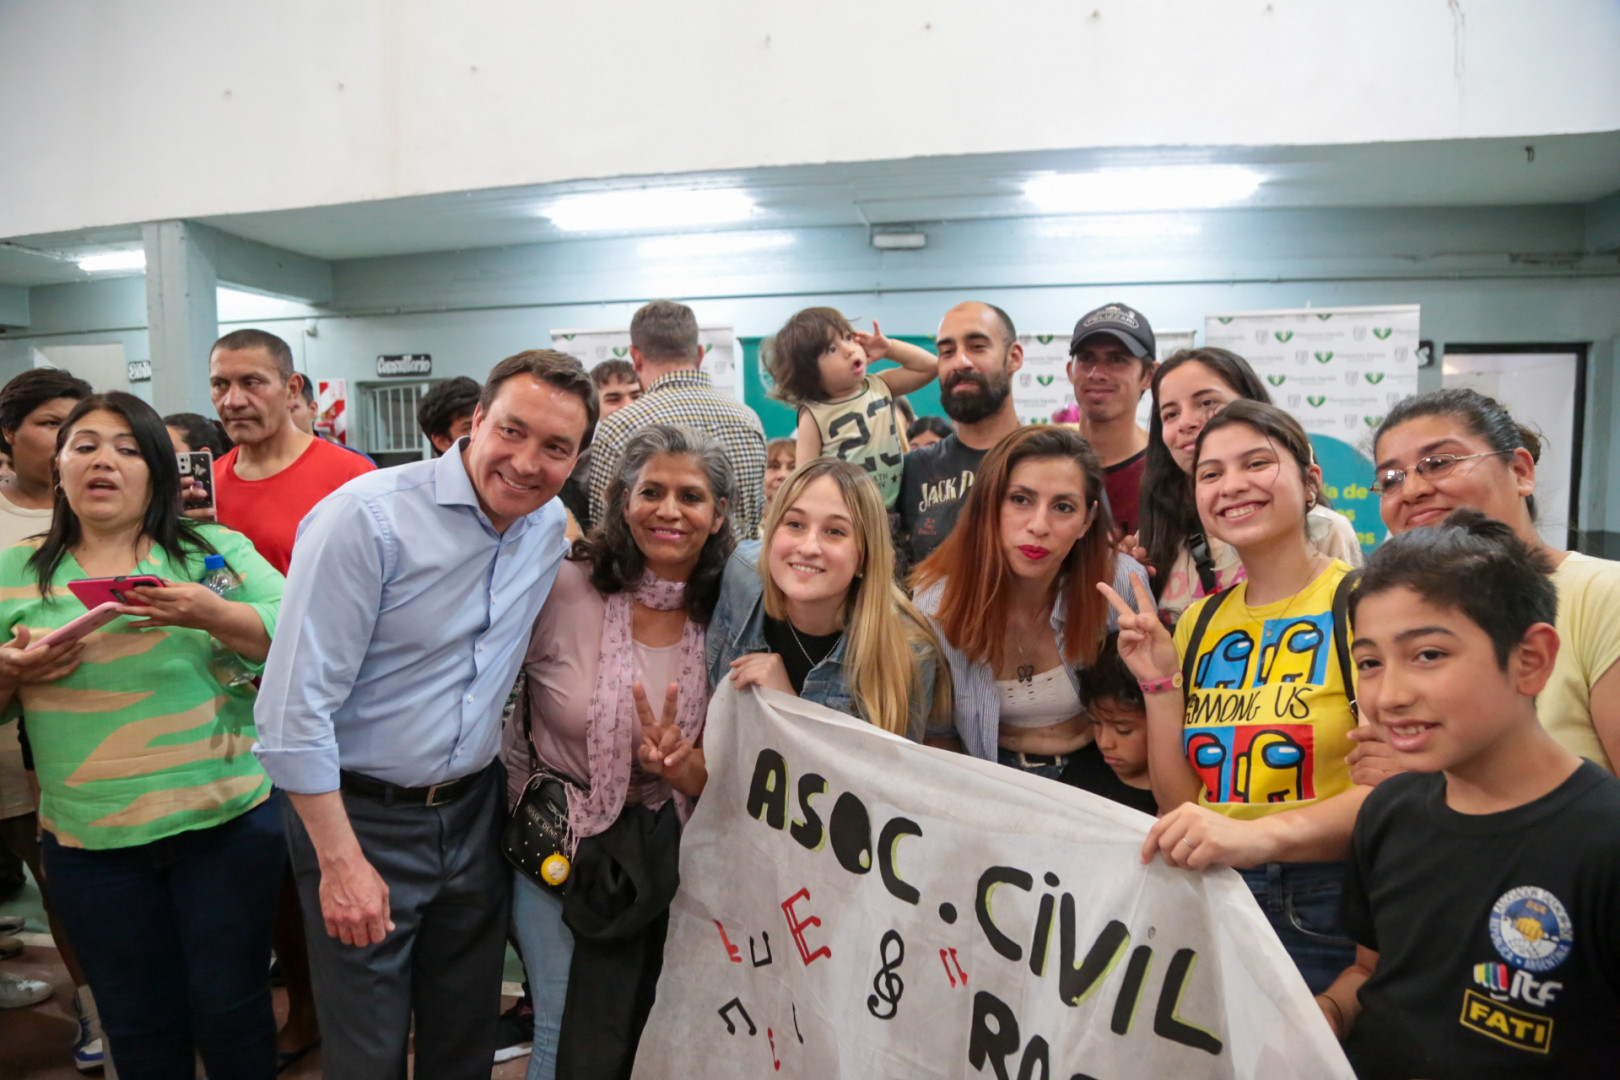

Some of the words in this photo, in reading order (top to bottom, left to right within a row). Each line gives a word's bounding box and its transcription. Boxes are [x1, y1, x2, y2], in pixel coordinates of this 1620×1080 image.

[919, 477, 957, 513] JACK
[959, 470, 976, 499] D
[1343, 483, 1368, 499] de
[1274, 686, 1313, 719] US
[1469, 1001, 1546, 1043] FATI
